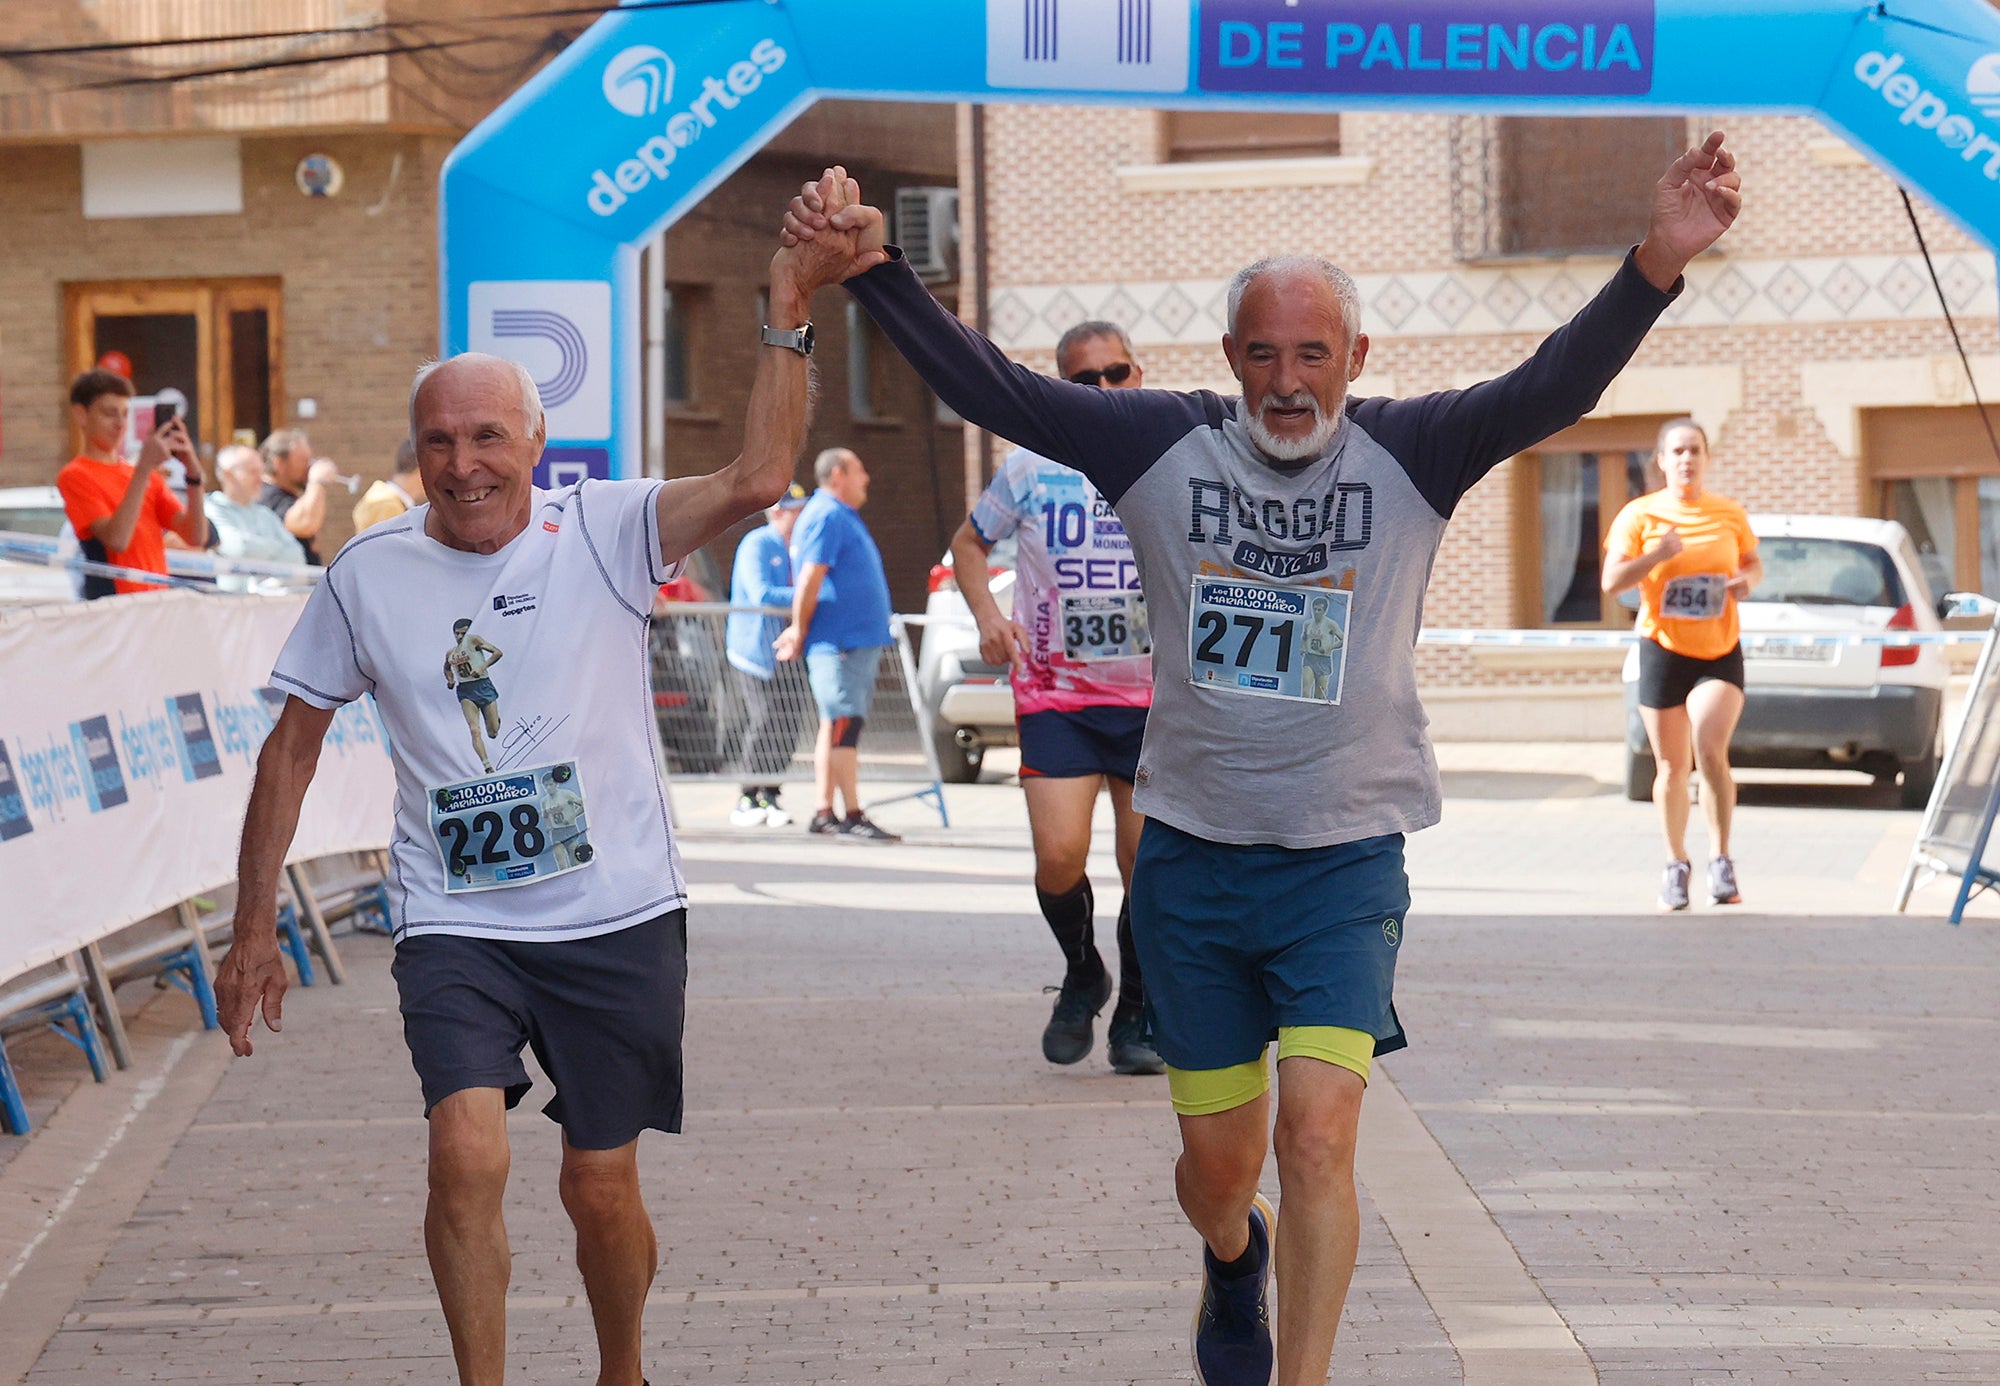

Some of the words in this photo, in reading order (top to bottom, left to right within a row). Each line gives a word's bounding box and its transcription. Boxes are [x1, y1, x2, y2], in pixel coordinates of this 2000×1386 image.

[1218, 21, 1304, 69] DE
[1326, 22, 1643, 72] PALENCIA
[587, 38, 787, 217] deportes
[1041, 501, 1086, 548] 10
[1241, 549, 1257, 565] 19
[1306, 551, 1321, 566] 78
[1208, 594, 1261, 609] MARIANO
[1263, 602, 1297, 613] HARO
[1228, 587, 1277, 602] 10.000
[1665, 587, 1708, 608] 254
[1066, 613, 1127, 647] 336
[1196, 610, 1294, 673] 271
[459, 782, 506, 799] 10.000
[496, 788, 529, 801] HARO
[439, 804, 546, 866] 228
